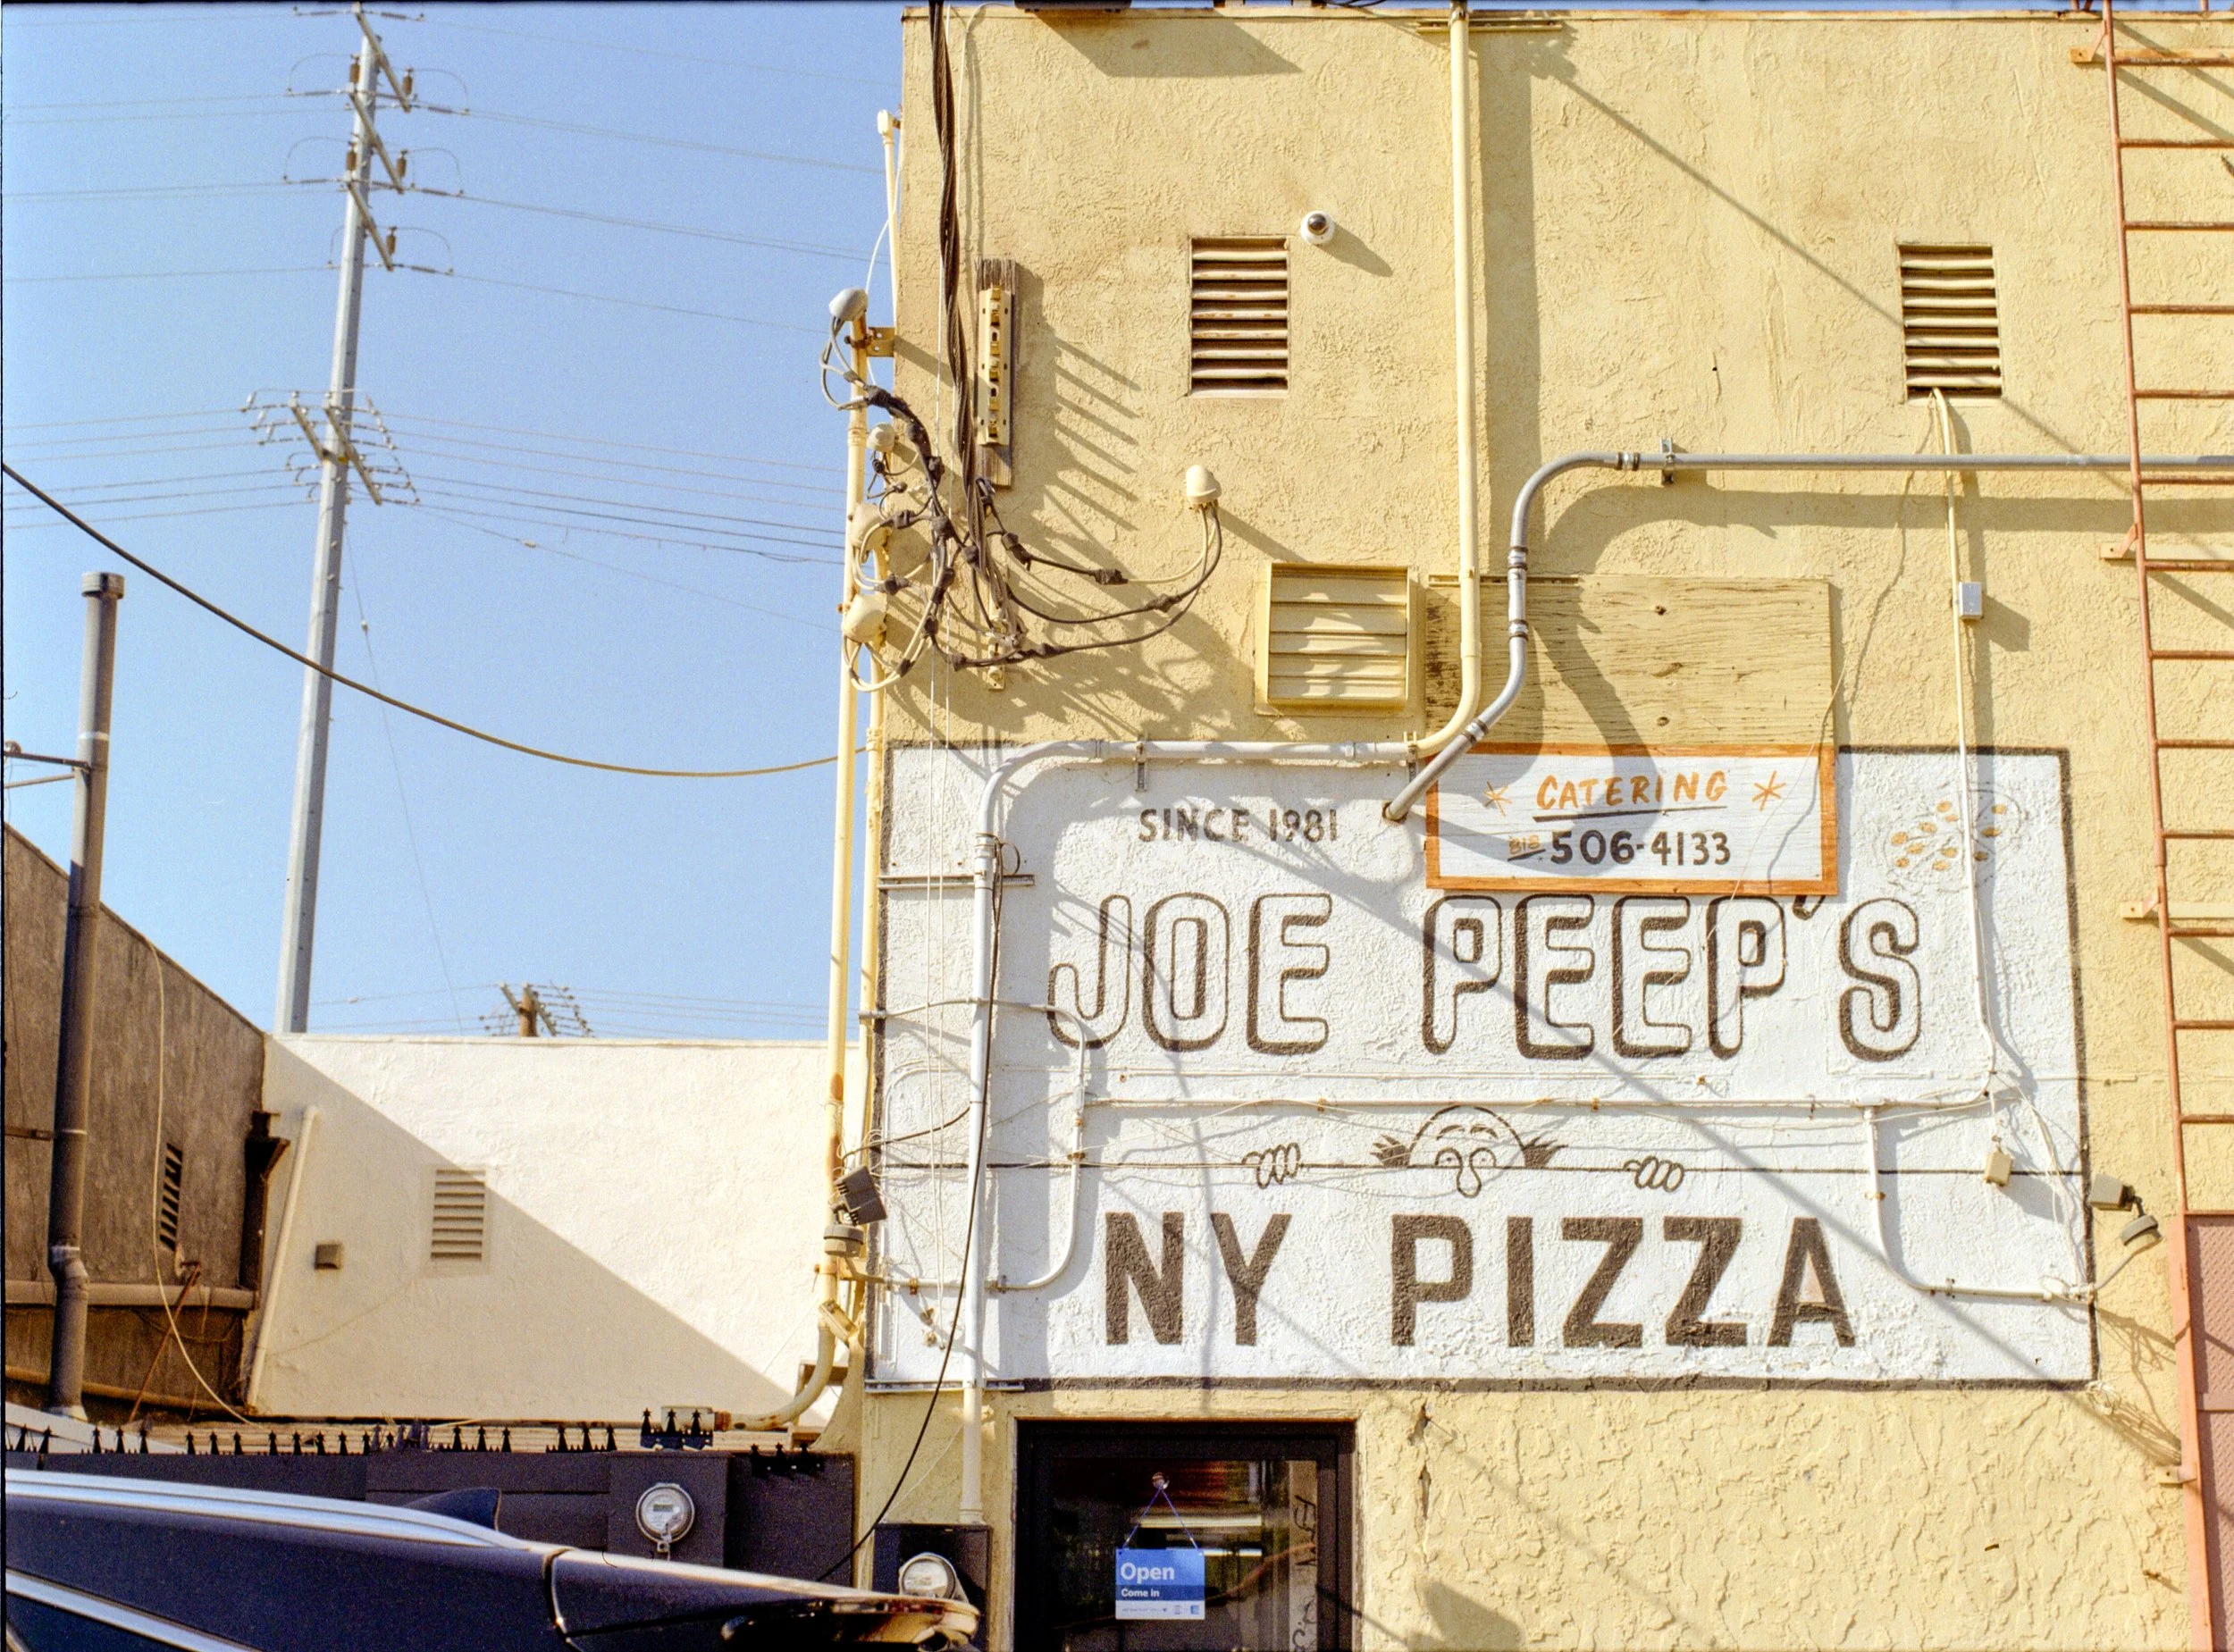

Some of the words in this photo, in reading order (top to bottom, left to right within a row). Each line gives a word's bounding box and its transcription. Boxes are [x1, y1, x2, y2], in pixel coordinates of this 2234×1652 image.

[1536, 770, 1727, 809] CATERING
[1138, 808, 1249, 843] SINCE
[1268, 808, 1338, 843] 1981
[1550, 829, 1731, 866] 506-4133
[1047, 892, 1332, 1055] JOE
[1422, 893, 1922, 1062] PEEP'S
[1104, 1212, 1291, 1346] NY
[1390, 1214, 1856, 1349] PIZZA
[1120, 1562, 1176, 1585] Open
[1121, 1588, 1148, 1597] Come
[1150, 1588, 1160, 1597] in
